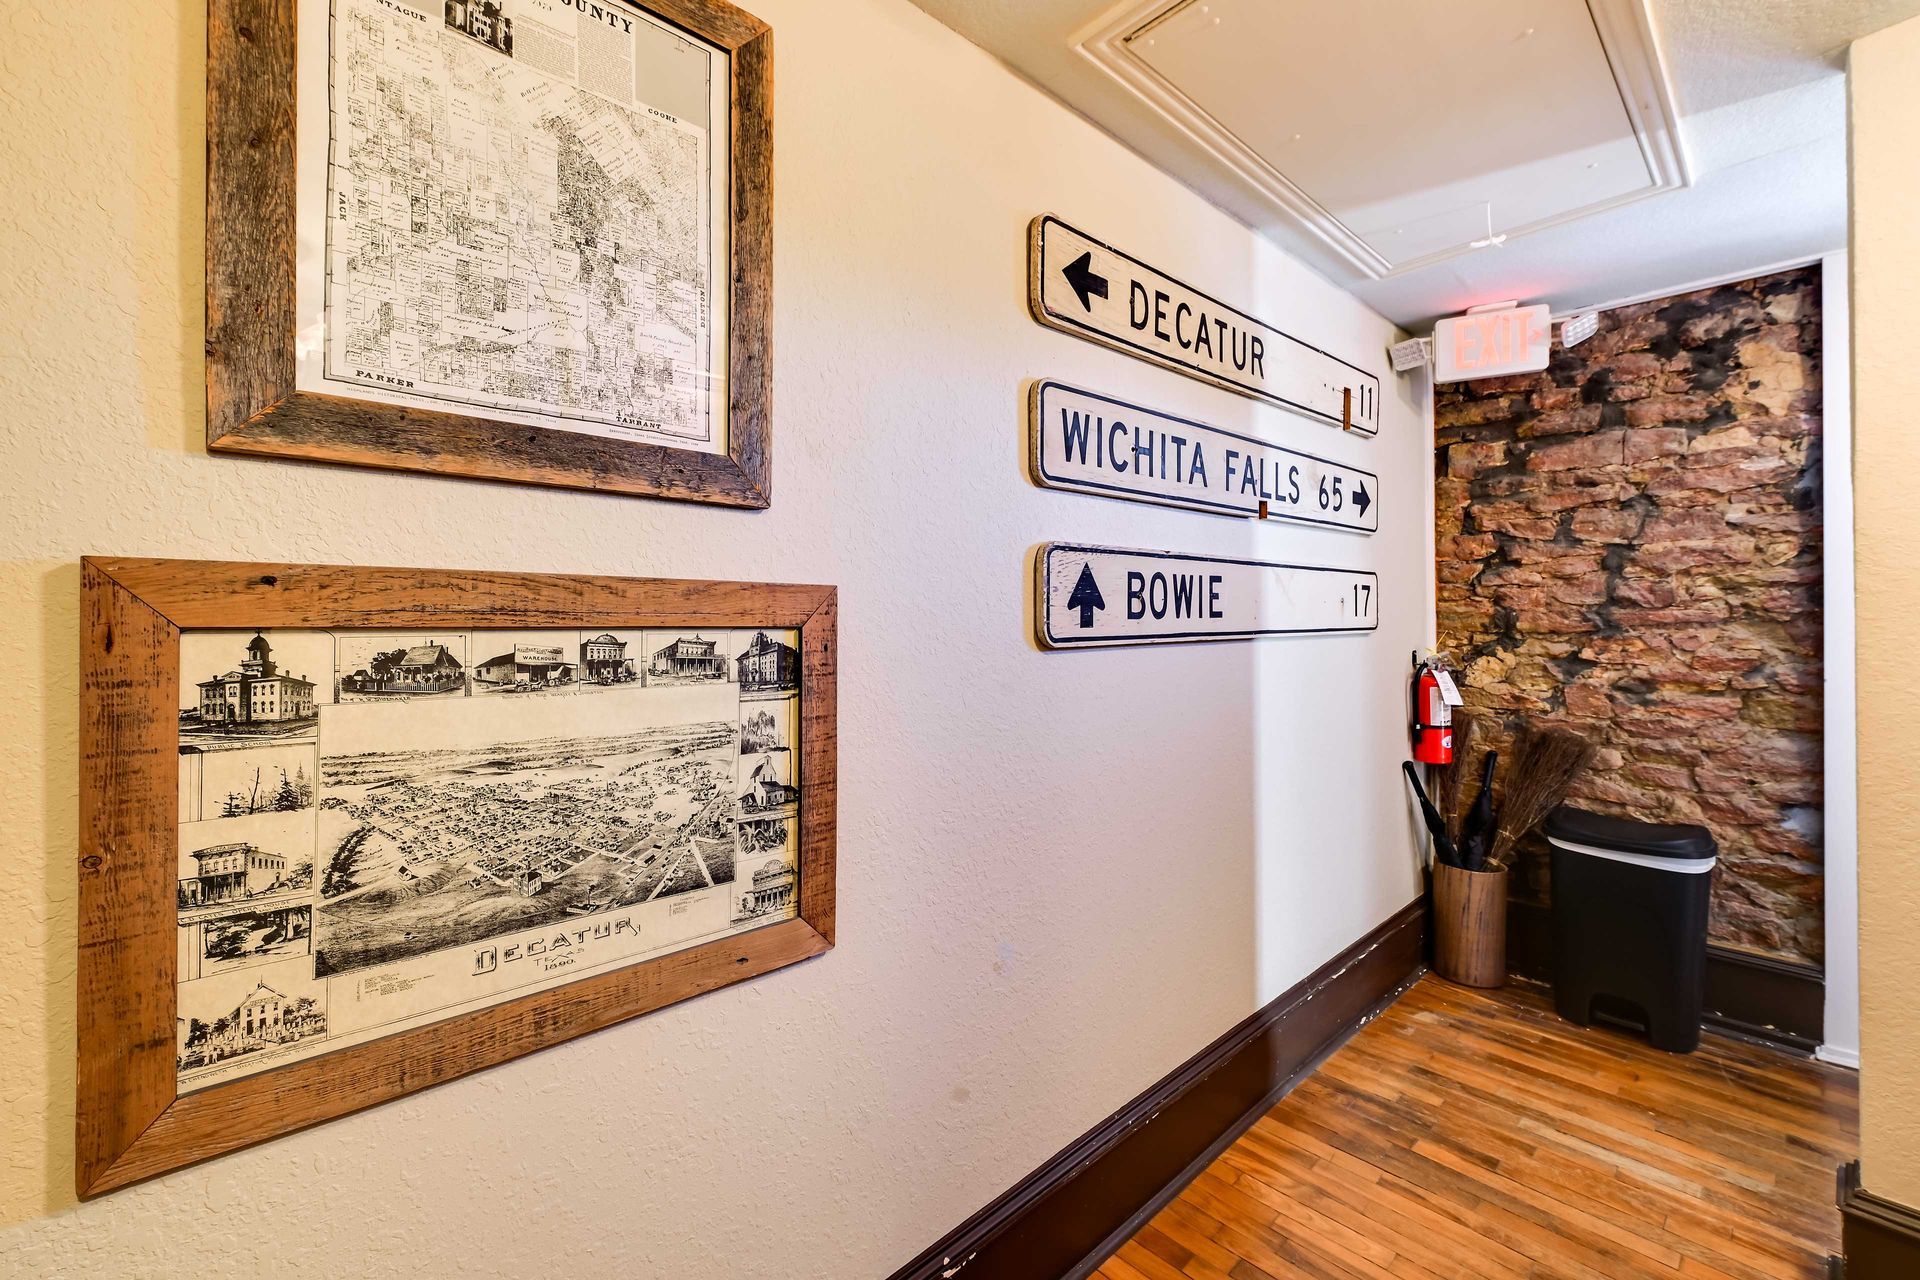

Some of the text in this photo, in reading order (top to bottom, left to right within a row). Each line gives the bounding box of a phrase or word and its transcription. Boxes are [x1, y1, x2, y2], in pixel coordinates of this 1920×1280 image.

[647, 107, 678, 124] COOKE
[338, 191, 347, 222] JACK
[1130, 279, 1373, 421] DECATUR 11
[1453, 312, 1535, 372] EXIT
[355, 369, 415, 389] PARKER
[615, 415, 662, 430] TARRANT
[1061, 408, 1343, 512] WICHITA FALLS 65
[1127, 570, 1371, 619] BOWIE 17
[533, 947, 585, 966] TEXAS
